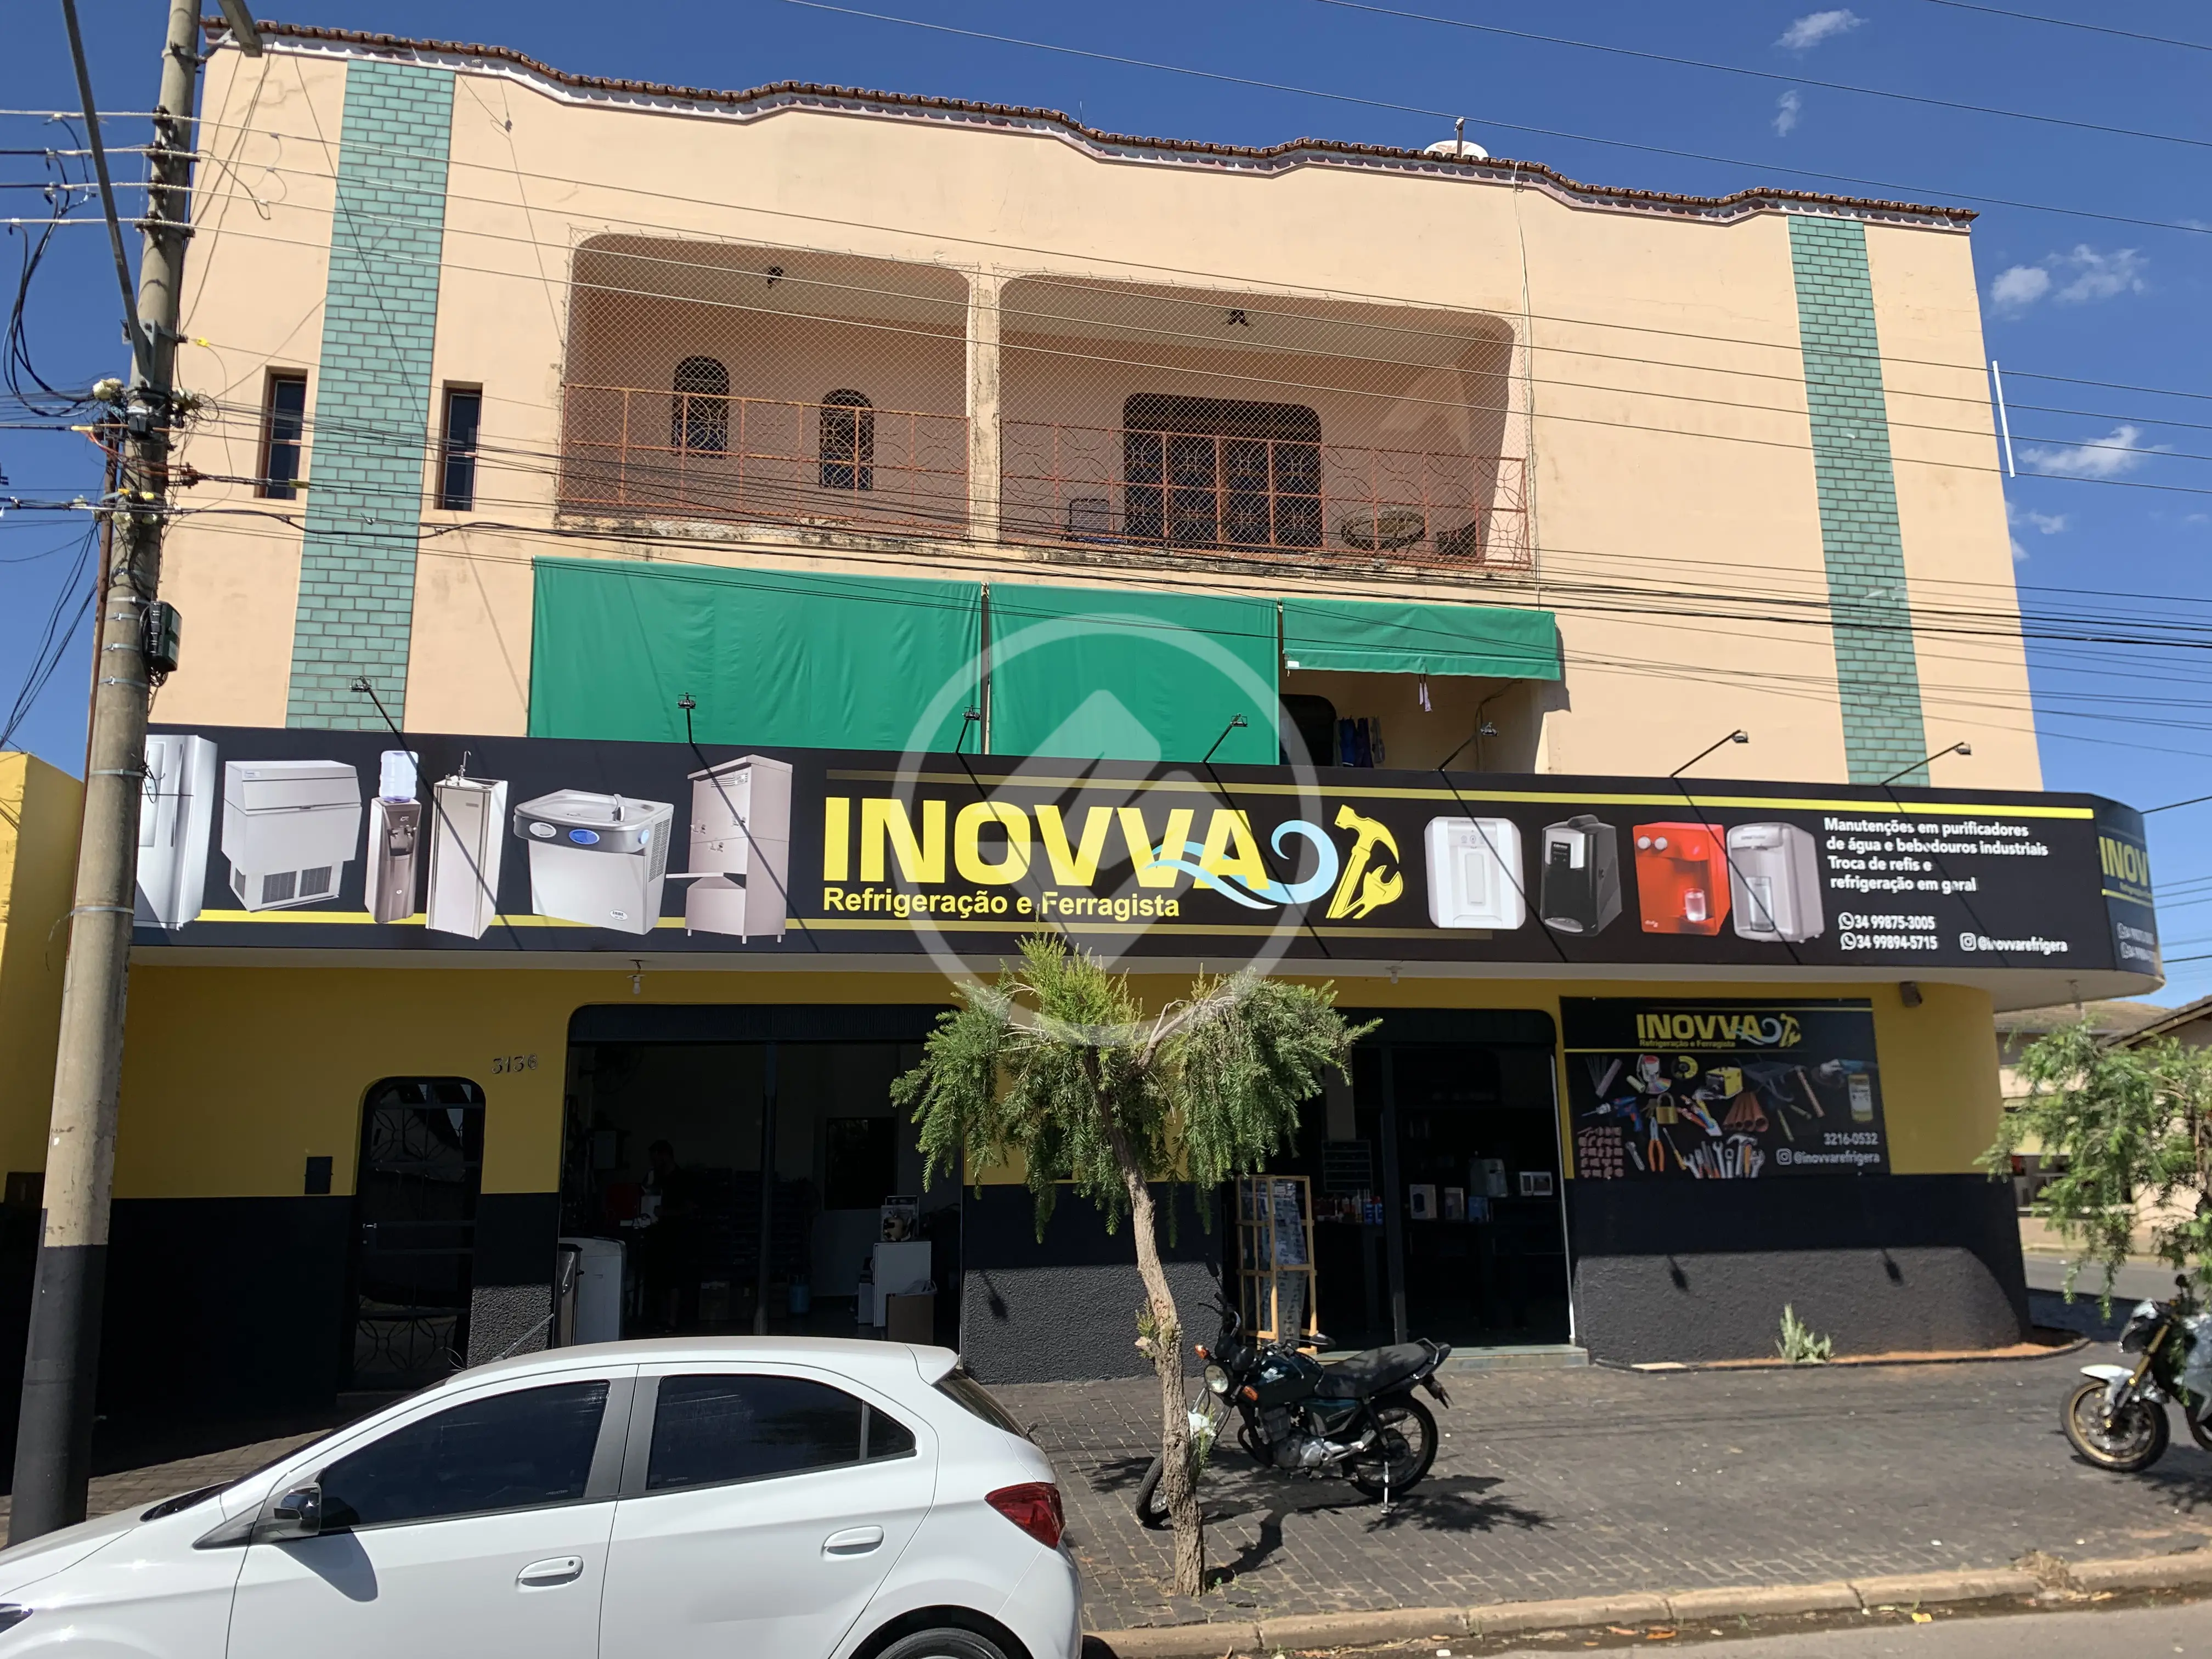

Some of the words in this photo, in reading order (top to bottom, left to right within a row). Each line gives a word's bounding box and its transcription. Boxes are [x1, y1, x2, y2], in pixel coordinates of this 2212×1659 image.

[1824, 817, 1915, 836] Manutenções
[1917, 822, 1939, 834] em
[1942, 820, 2030, 838] purificadores
[823, 797, 1271, 890] INOVVA
[1826, 835, 1846, 851] de
[1848, 837, 1882, 855] água
[1883, 840, 1893, 851] e
[1895, 837, 1978, 854] bebedouros
[1979, 839, 2049, 856] industriais
[1827, 855, 1866, 870] Troca
[1868, 855, 1887, 871] de
[1889, 856, 1921, 871] refis
[1922, 860, 1932, 872] e
[1830, 873, 1915, 894] refrigeração
[1916, 879, 1939, 890] em
[1941, 877, 1977, 895] geral
[823, 887, 1008, 918] Refrigeração
[1017, 896, 1032, 915] e
[1042, 891, 1180, 922] Ferragista
[1854, 914, 1870, 929] 34
[1856, 934, 1872, 950] 34
[1637, 1013, 1763, 1040] INOVVA
[491, 1052, 538, 1074] 3136
